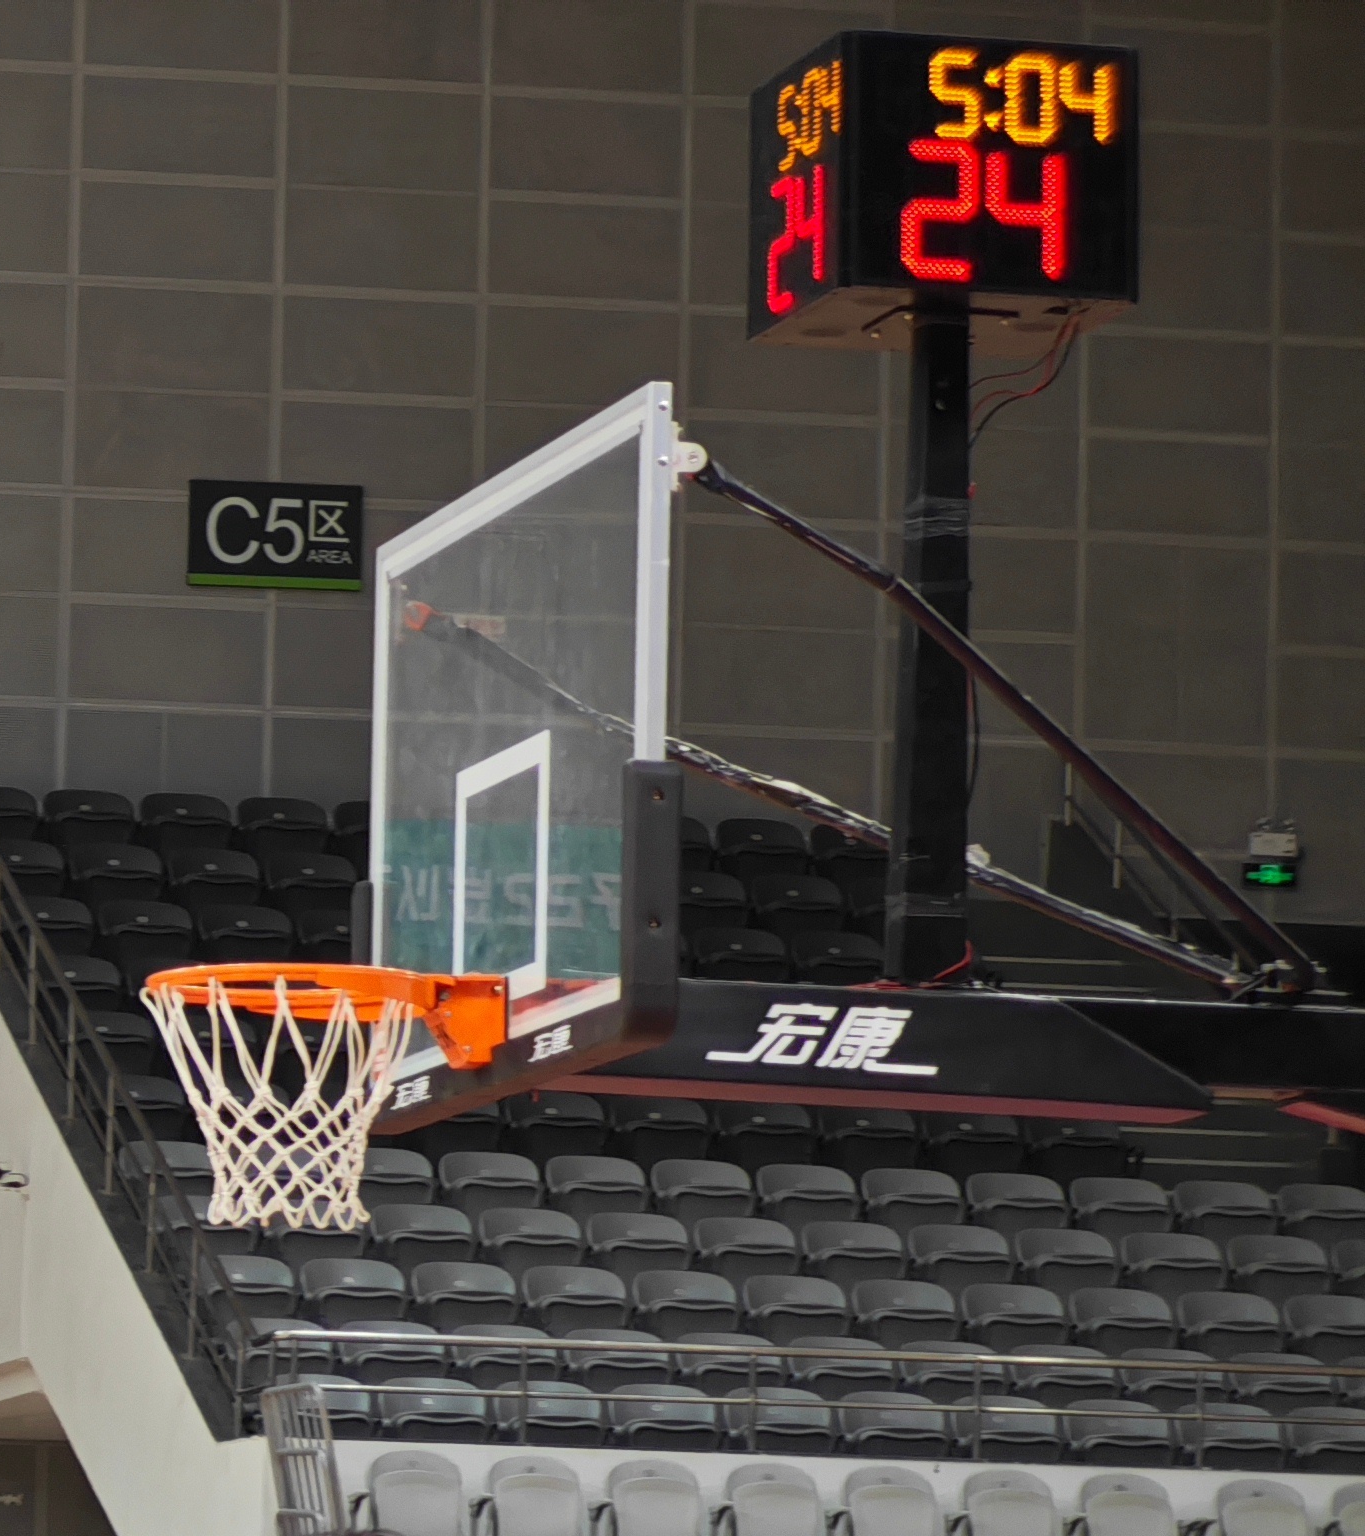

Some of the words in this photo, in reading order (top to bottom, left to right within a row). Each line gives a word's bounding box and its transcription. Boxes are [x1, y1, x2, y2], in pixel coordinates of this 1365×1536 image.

[929, 46, 1119, 147] 5:04
[768, 163, 825, 315] 24
[900, 138, 1069, 282] 24
[206, 496, 350, 564] C5区
[306, 549, 353, 565] AREA
[705, 1003, 939, 1066] 宏康
